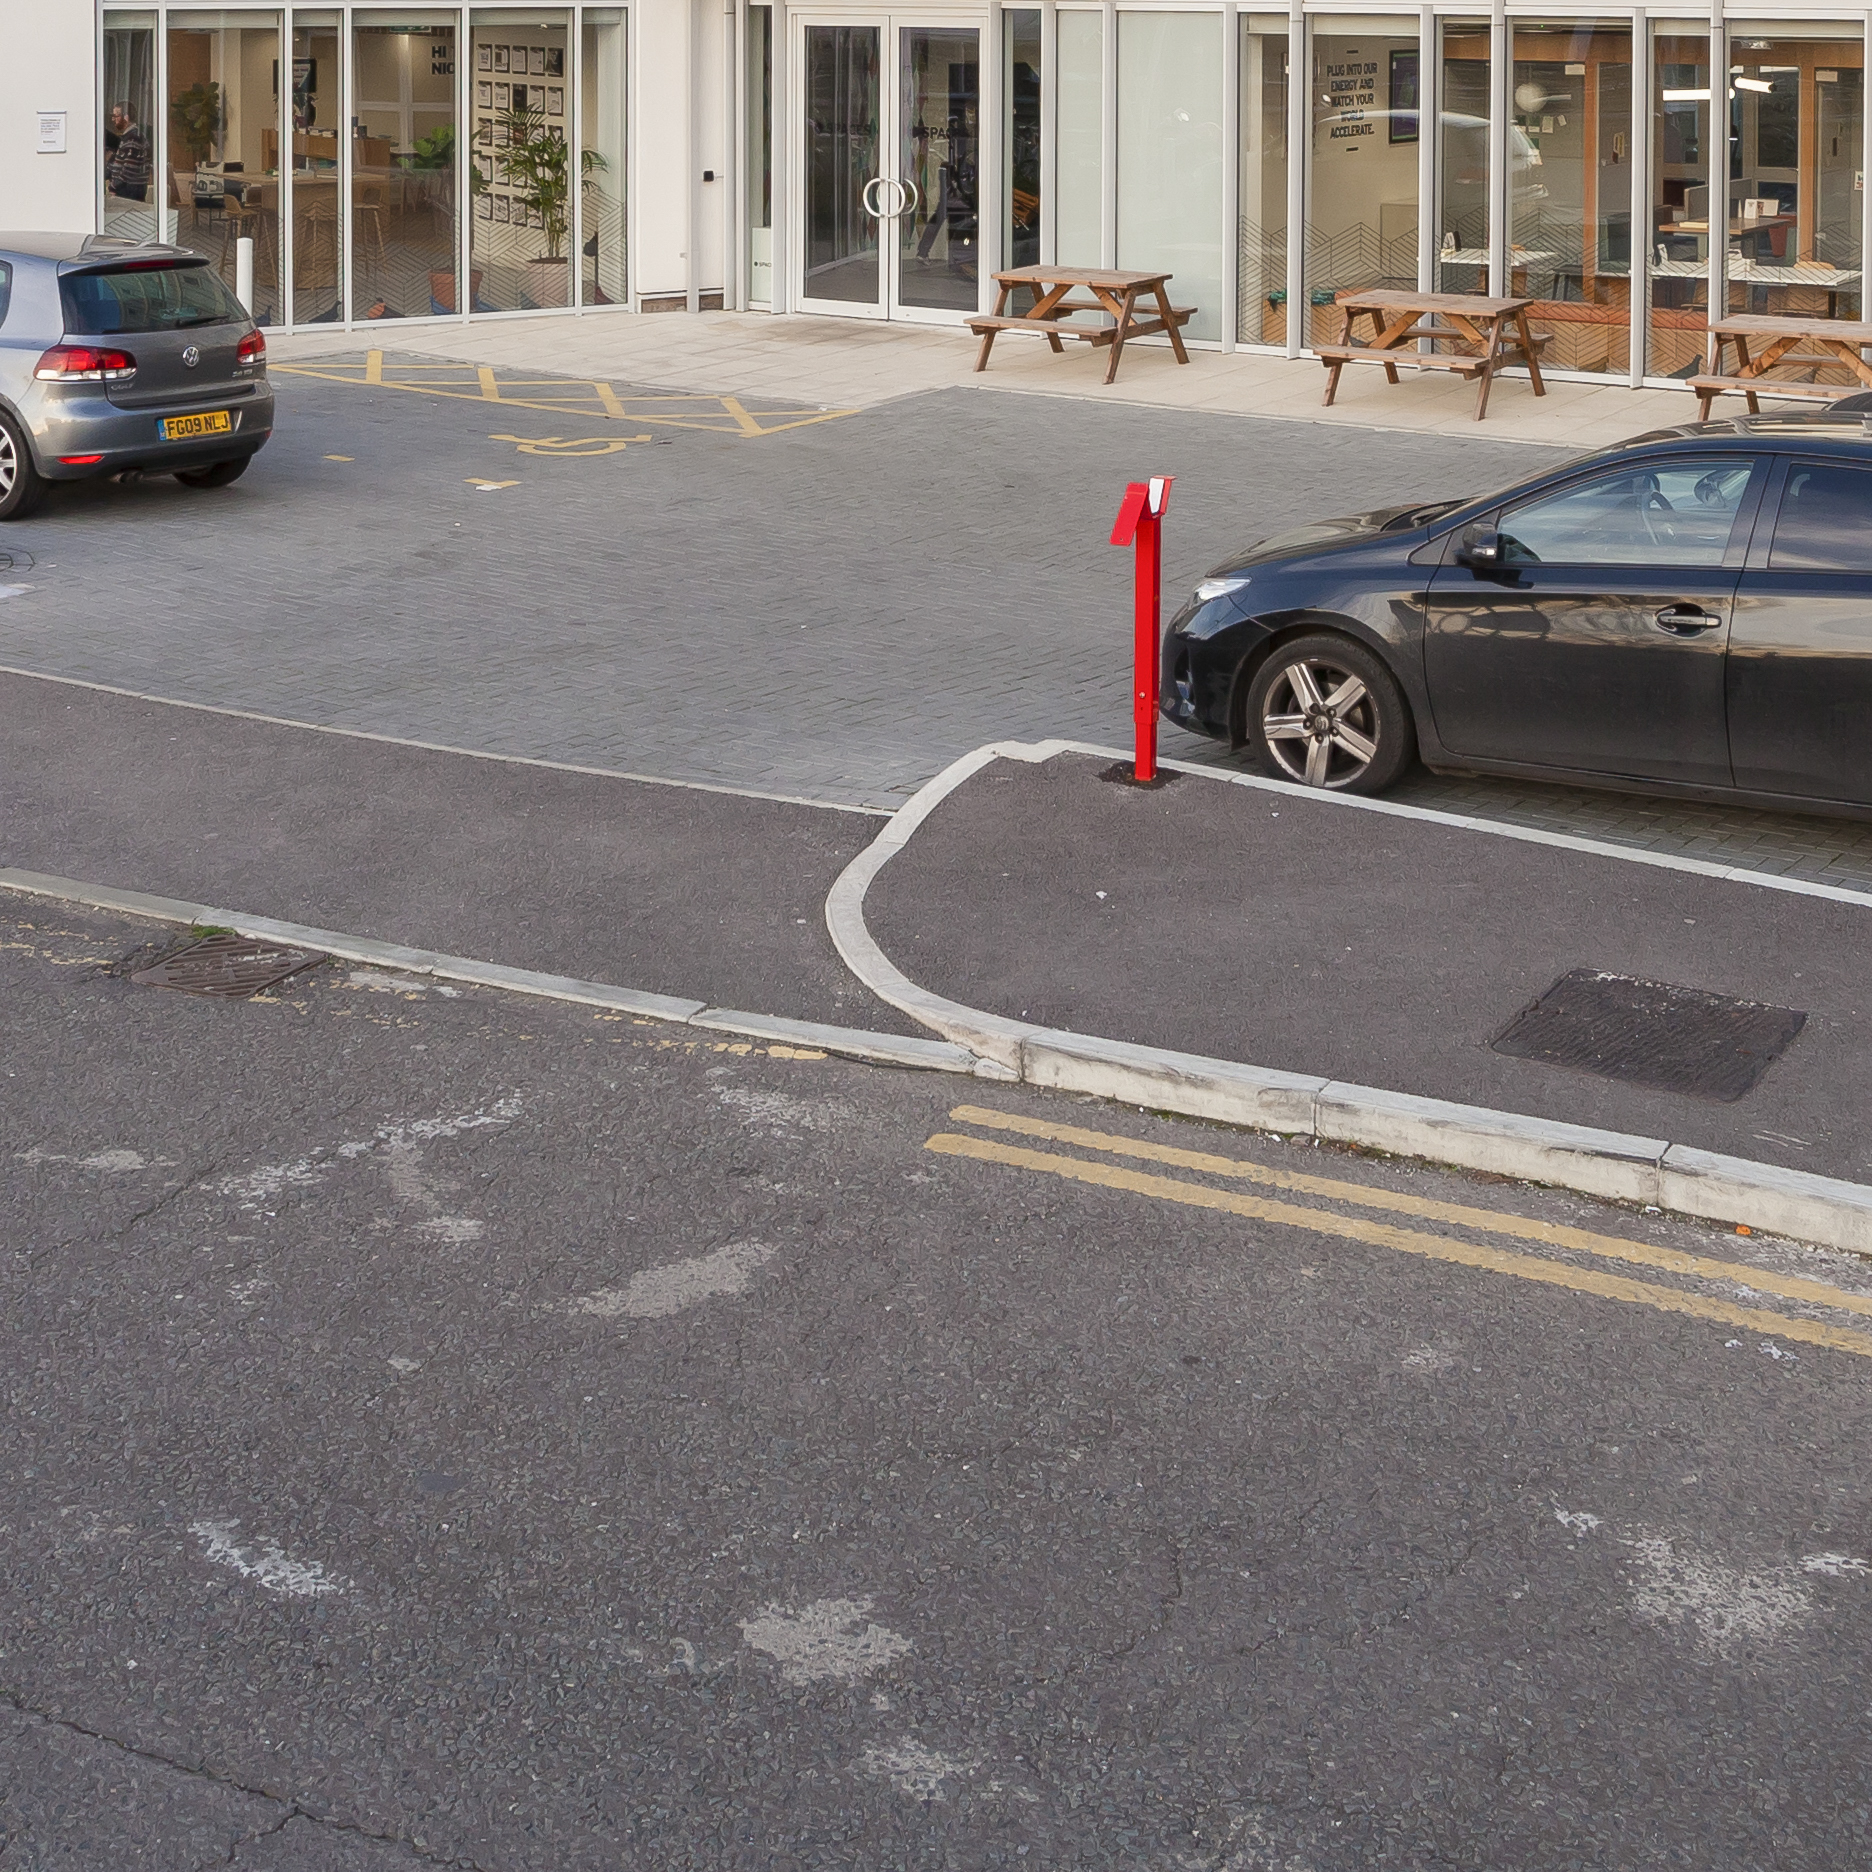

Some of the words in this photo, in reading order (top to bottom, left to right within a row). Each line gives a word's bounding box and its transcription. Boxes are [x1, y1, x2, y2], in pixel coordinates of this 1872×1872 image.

[431, 45, 447, 58] HI
[1326, 64, 1345, 77] PLUG
[1346, 63, 1362, 76] INTO
[1363, 62, 1378, 75] OUR
[1330, 79, 1358, 92] ENERGY
[1359, 77, 1374, 90] AND
[1330, 94, 1355, 107] WATCH
[1355, 93, 1374, 106] YOUR
[1330, 123, 1375, 139] ACCELERATE.
[167, 417, 202, 437] FG09
[203, 414, 229, 431] NLJ
